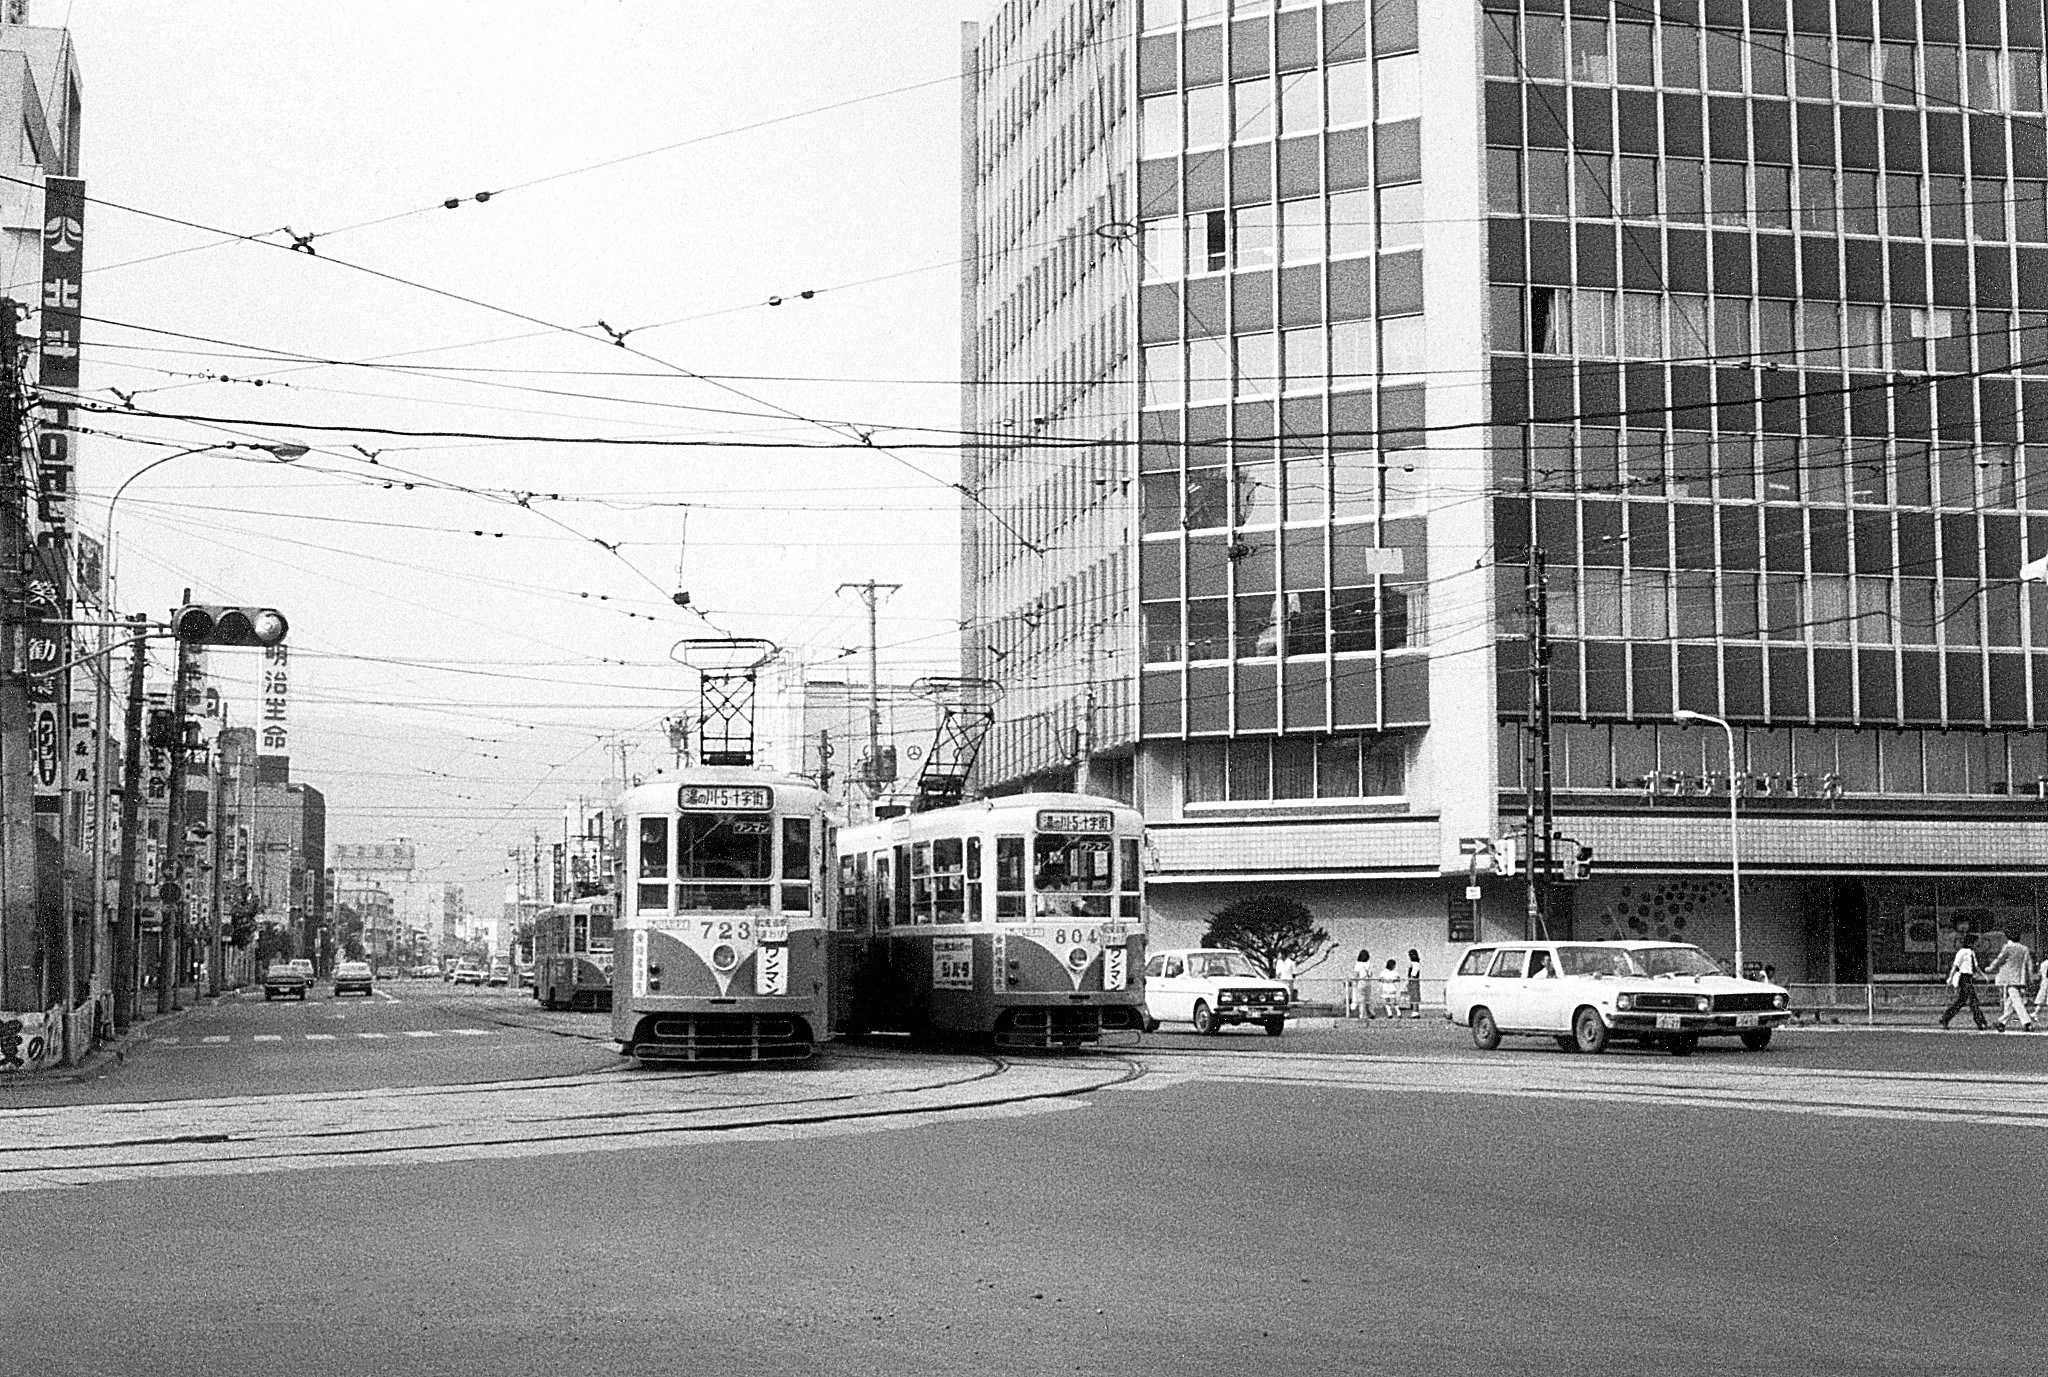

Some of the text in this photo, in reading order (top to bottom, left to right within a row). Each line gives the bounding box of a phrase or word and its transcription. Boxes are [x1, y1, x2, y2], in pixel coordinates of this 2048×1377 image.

[263, 644, 288, 749] 明治生命
[734, 822, 769, 833] ワンマン
[700, 922, 750, 940] 723
[1055, 929, 1098, 944] 804
[765, 944, 779, 995] ワンマン
[1110, 948, 1121, 991] ワンマン
